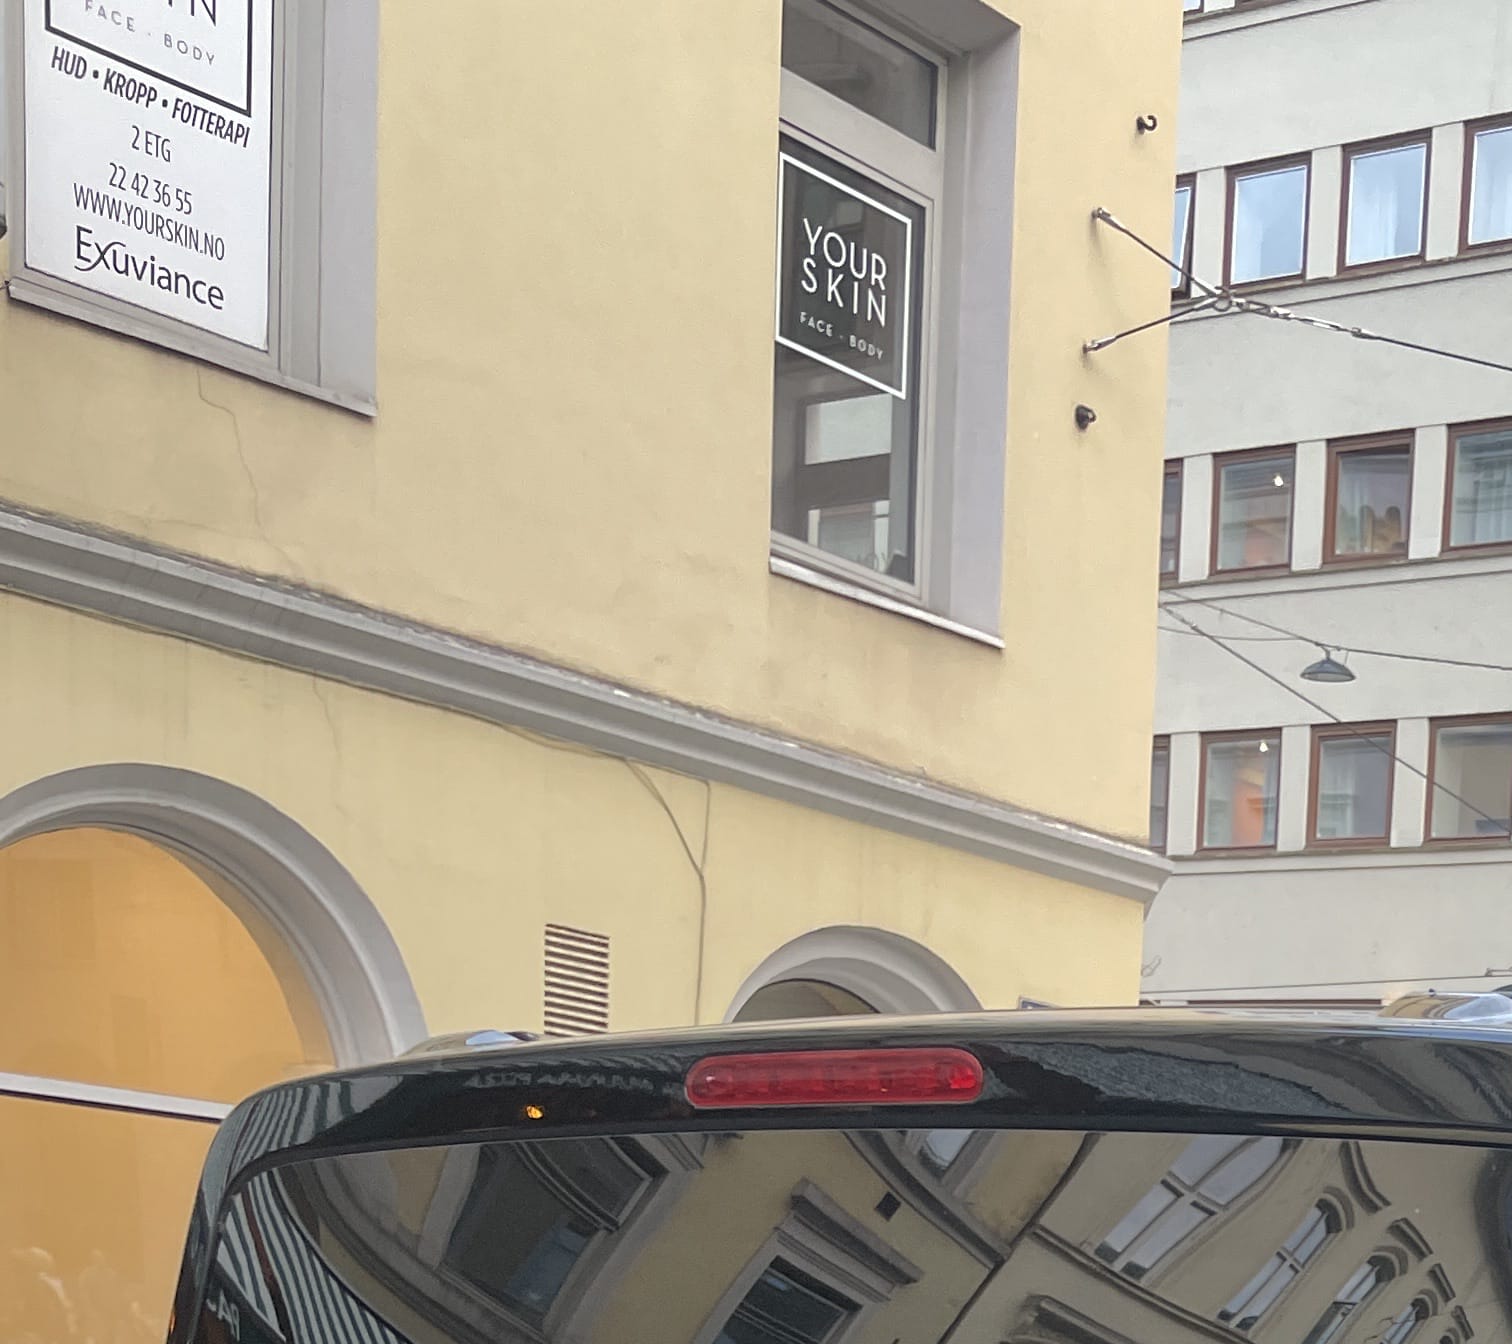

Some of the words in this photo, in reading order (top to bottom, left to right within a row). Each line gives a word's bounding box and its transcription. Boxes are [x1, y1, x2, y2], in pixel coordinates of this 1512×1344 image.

[163, 33, 215, 66] BODY
[51, 46, 87, 80] HUD
[103, 68, 157, 109] KROPP
[172, 98, 251, 149] FOTTERAPI
[131, 125, 140, 151] 2
[145, 131, 171, 162] ETG
[73, 183, 225, 261] WWW.YOURSKIN.NO
[109, 162, 126, 190] 22
[130, 171, 149, 200] 42
[153, 178, 171, 207] 36
[175, 187, 193, 215] 55
[74, 225, 225, 311] Exuviance
[803, 217, 888, 291] YOUR
[801, 257, 887, 328] SKIN
[800, 311, 834, 337] FACE
[849, 335, 884, 361] BODY
